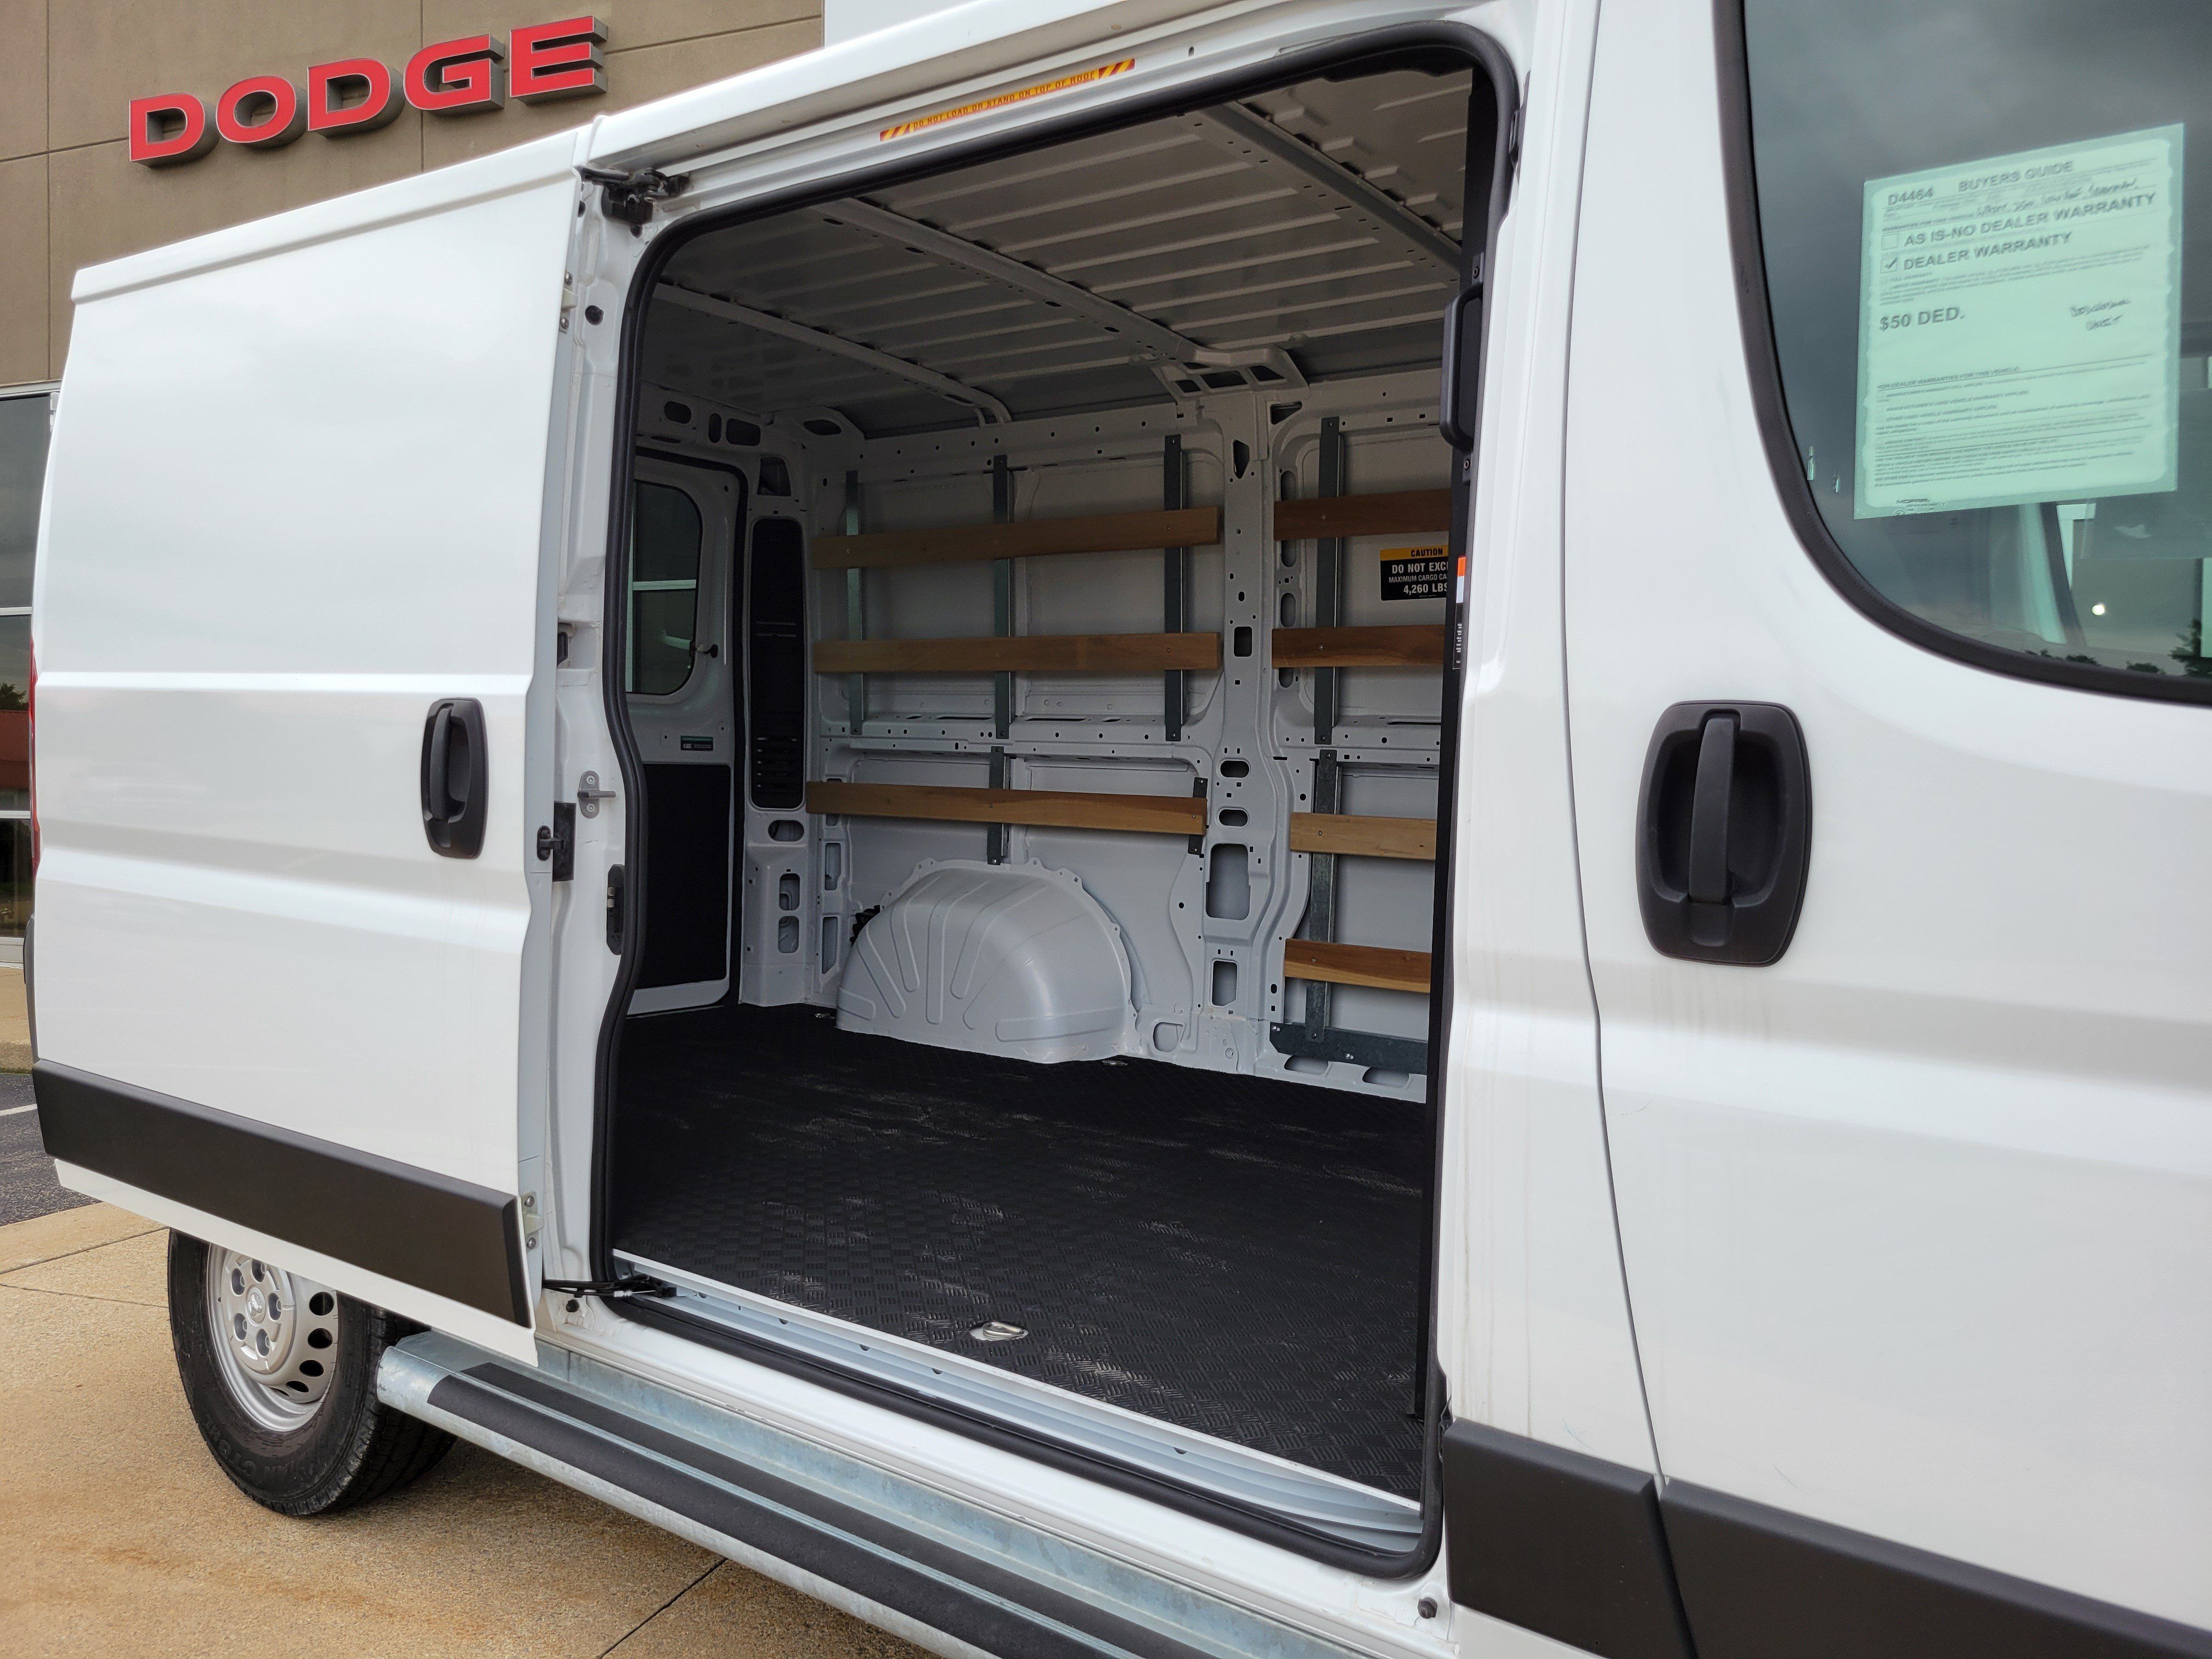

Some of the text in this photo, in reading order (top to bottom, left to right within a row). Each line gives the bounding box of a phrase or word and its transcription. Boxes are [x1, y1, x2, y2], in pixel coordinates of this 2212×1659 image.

[129, 15, 602, 163] DODGE
[913, 120, 924, 128] DO
[927, 115, 943, 125] NOT
[947, 107, 968, 119] LOAD
[987, 94, 1015, 107] STAND
[1019, 91, 1031, 99] ON
[1035, 84, 1051, 94] TOP
[1888, 186, 1934, 206] D4464
[1958, 170, 2020, 193] BUYERS
[2024, 160, 2074, 180] GUIDE
[1904, 232, 1926, 246] AS
[1930, 223, 1976, 242] IS-NO
[1980, 211, 2049, 234] DEALER
[2053, 191, 2156, 222] WARRANTY
[1903, 249, 1970, 270] DEALER
[1973, 230, 2072, 259] WARRANTY
[1879, 305, 1965, 332] $50 DED.
[1392, 561, 1448, 574] DO NOT EXC
[1410, 548, 1443, 557] CAUTION
[1389, 574, 1417, 583] MAXIMUM
[1418, 573, 1437, 582] CARGO
[1403, 584, 1429, 595] 4,260
